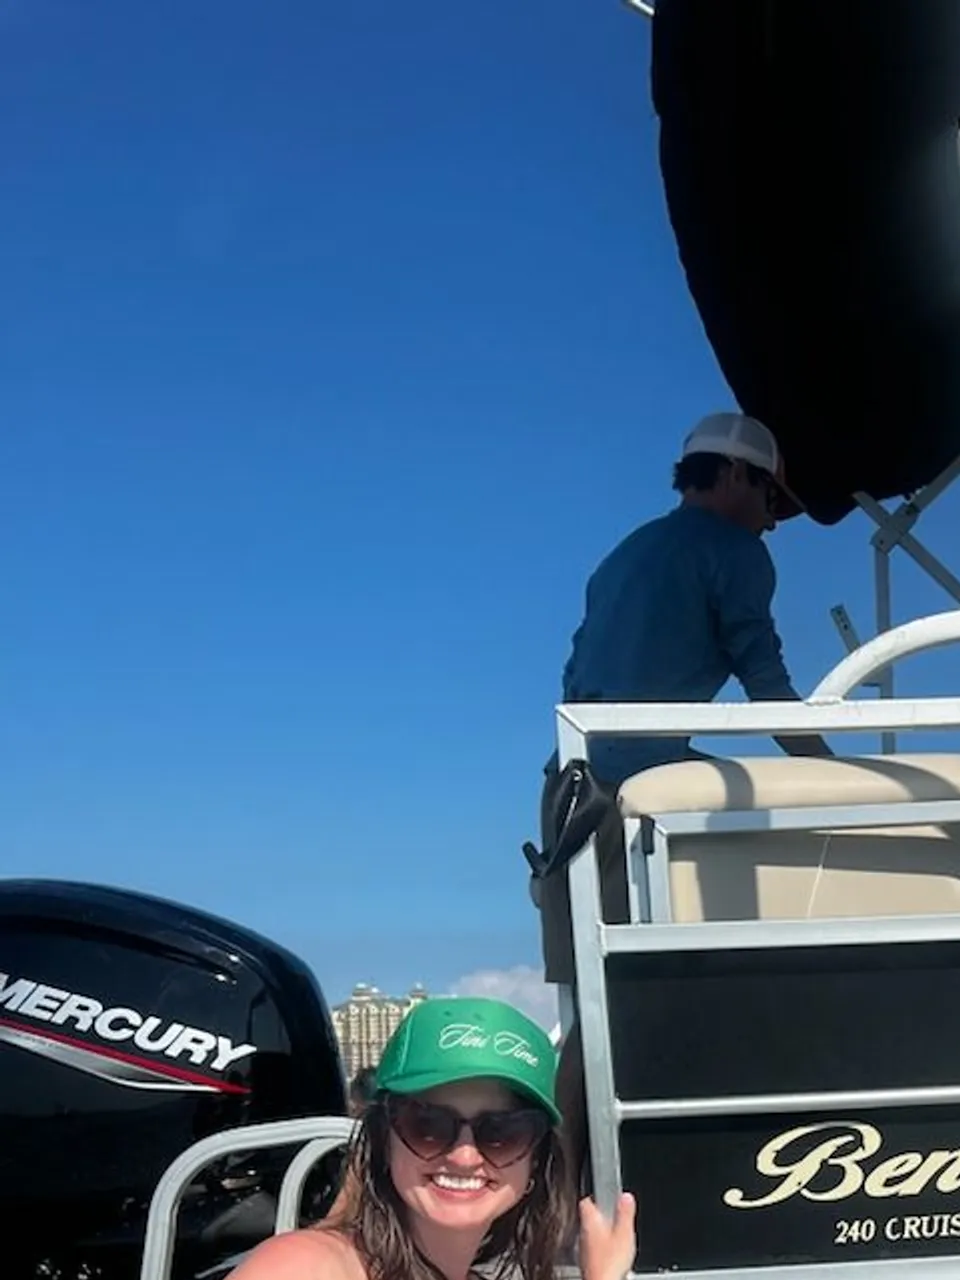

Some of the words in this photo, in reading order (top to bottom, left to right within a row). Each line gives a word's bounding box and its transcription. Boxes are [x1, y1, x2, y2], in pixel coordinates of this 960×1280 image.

[0, 974, 257, 1072] MERCURY
[494, 1030, 539, 1067] Time
[834, 1219, 876, 1244] 240
